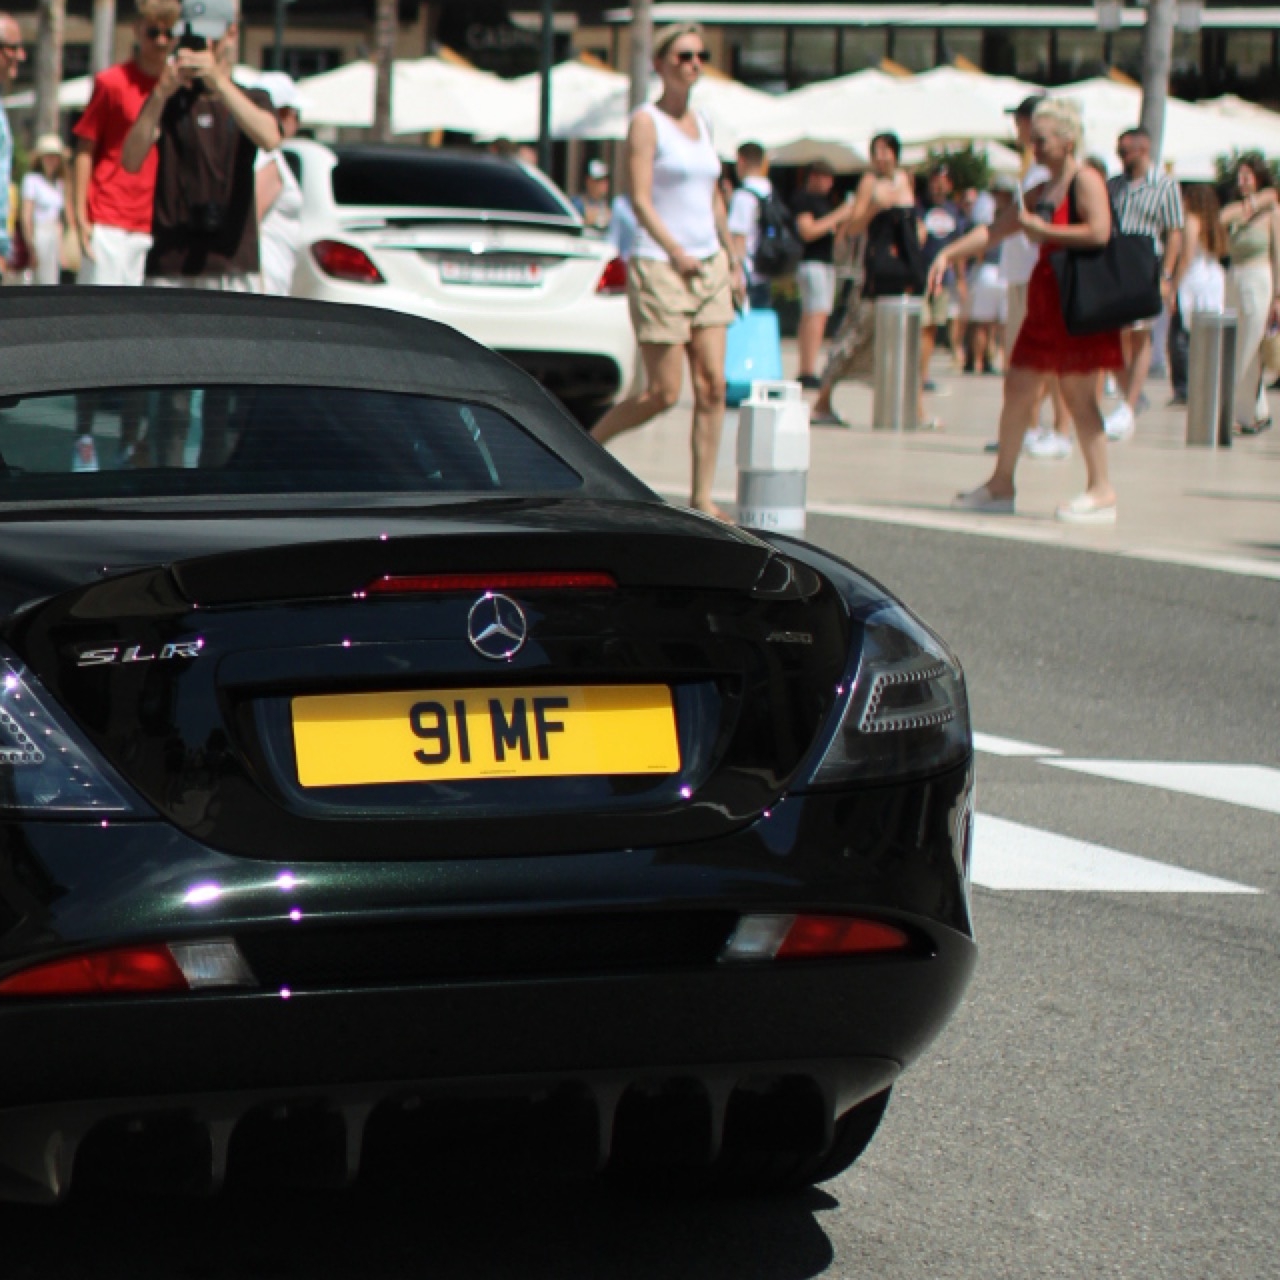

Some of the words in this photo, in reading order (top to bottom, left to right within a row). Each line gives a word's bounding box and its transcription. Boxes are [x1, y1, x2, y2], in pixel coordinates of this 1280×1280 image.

[77, 640, 203, 666] SLR
[409, 700, 471, 765] 91
[488, 697, 569, 762] MF
